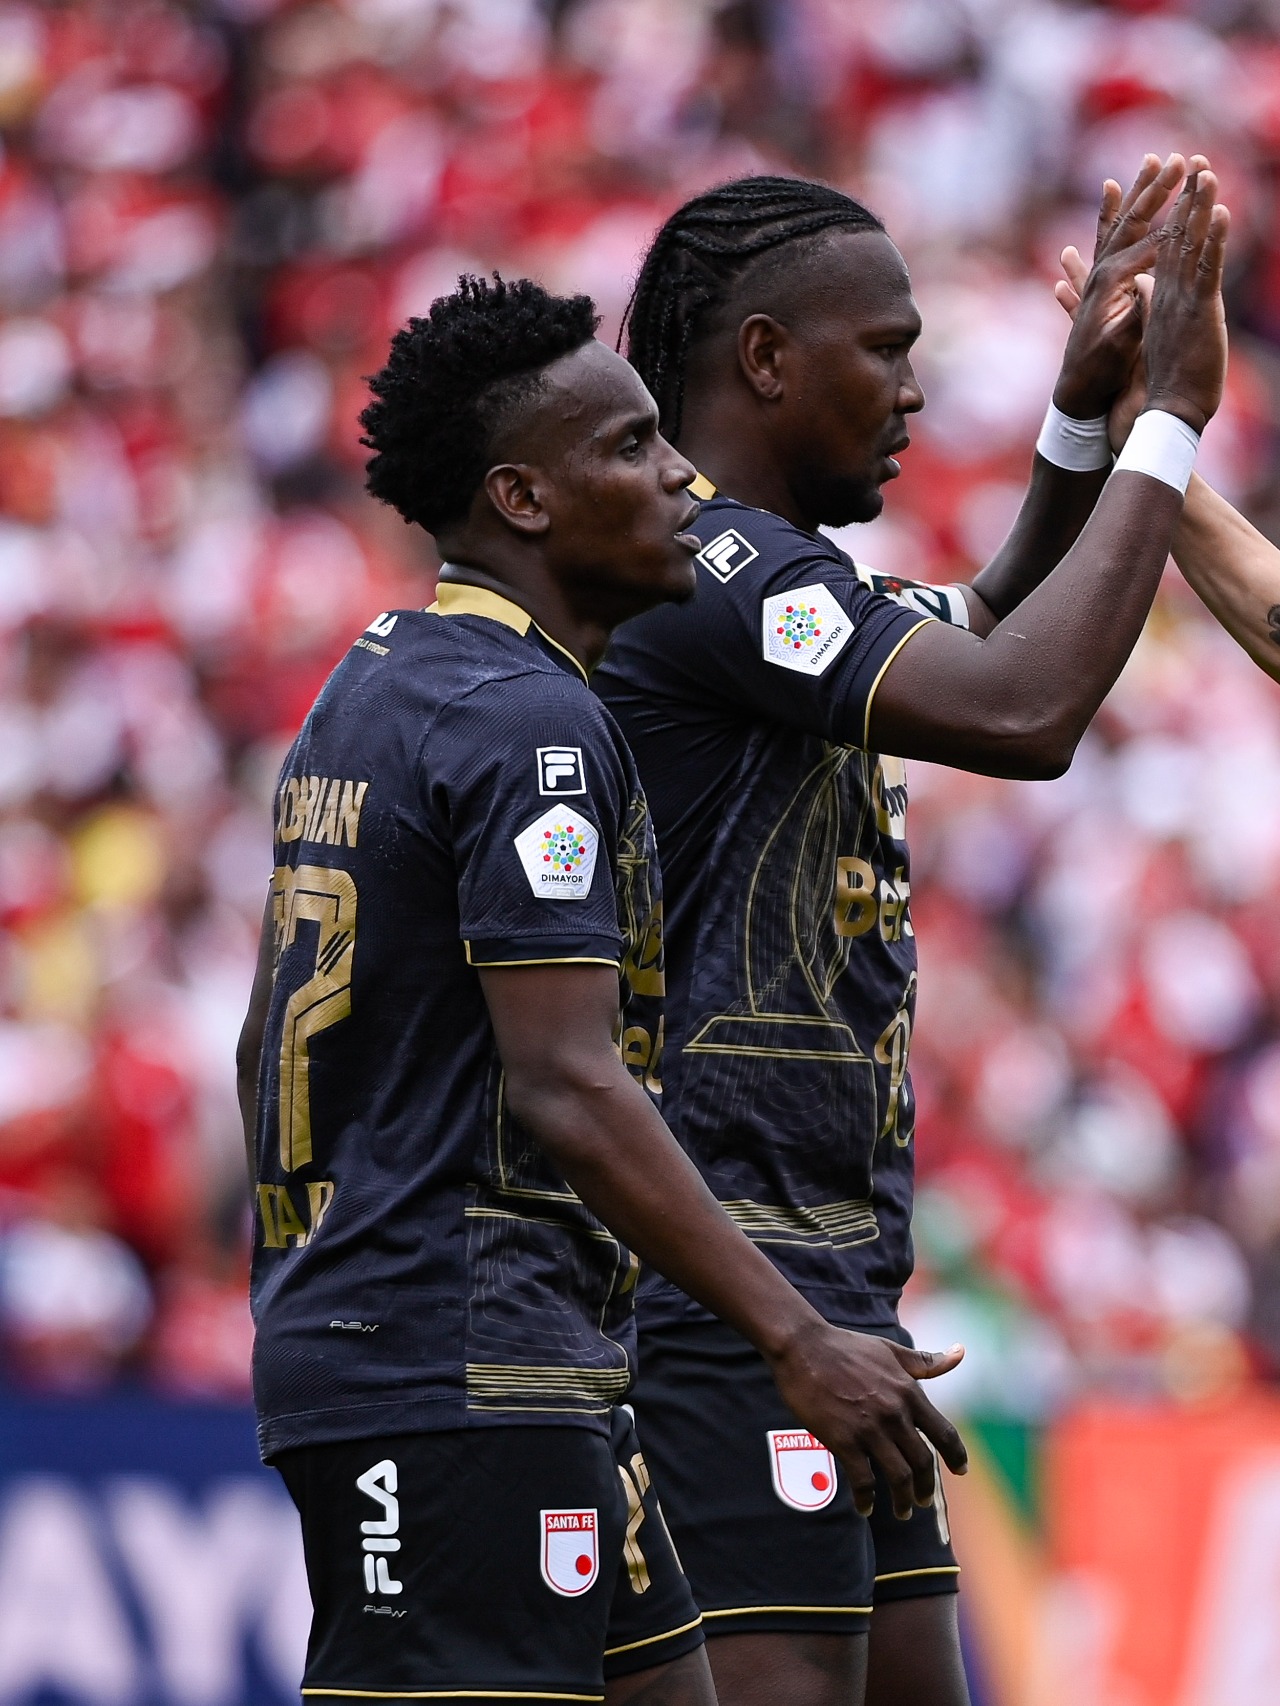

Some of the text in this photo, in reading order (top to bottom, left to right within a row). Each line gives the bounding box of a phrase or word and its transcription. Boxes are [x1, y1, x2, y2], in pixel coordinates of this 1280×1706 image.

[810, 624, 844, 666] DIMAYOR
[275, 776, 369, 848] ORIAN
[541, 874, 584, 884] DIMAYOR
[775, 1435, 813, 1449] SANTA
[355, 1458, 403, 1596] FILA
[547, 1515, 594, 1530] SANTA FE
